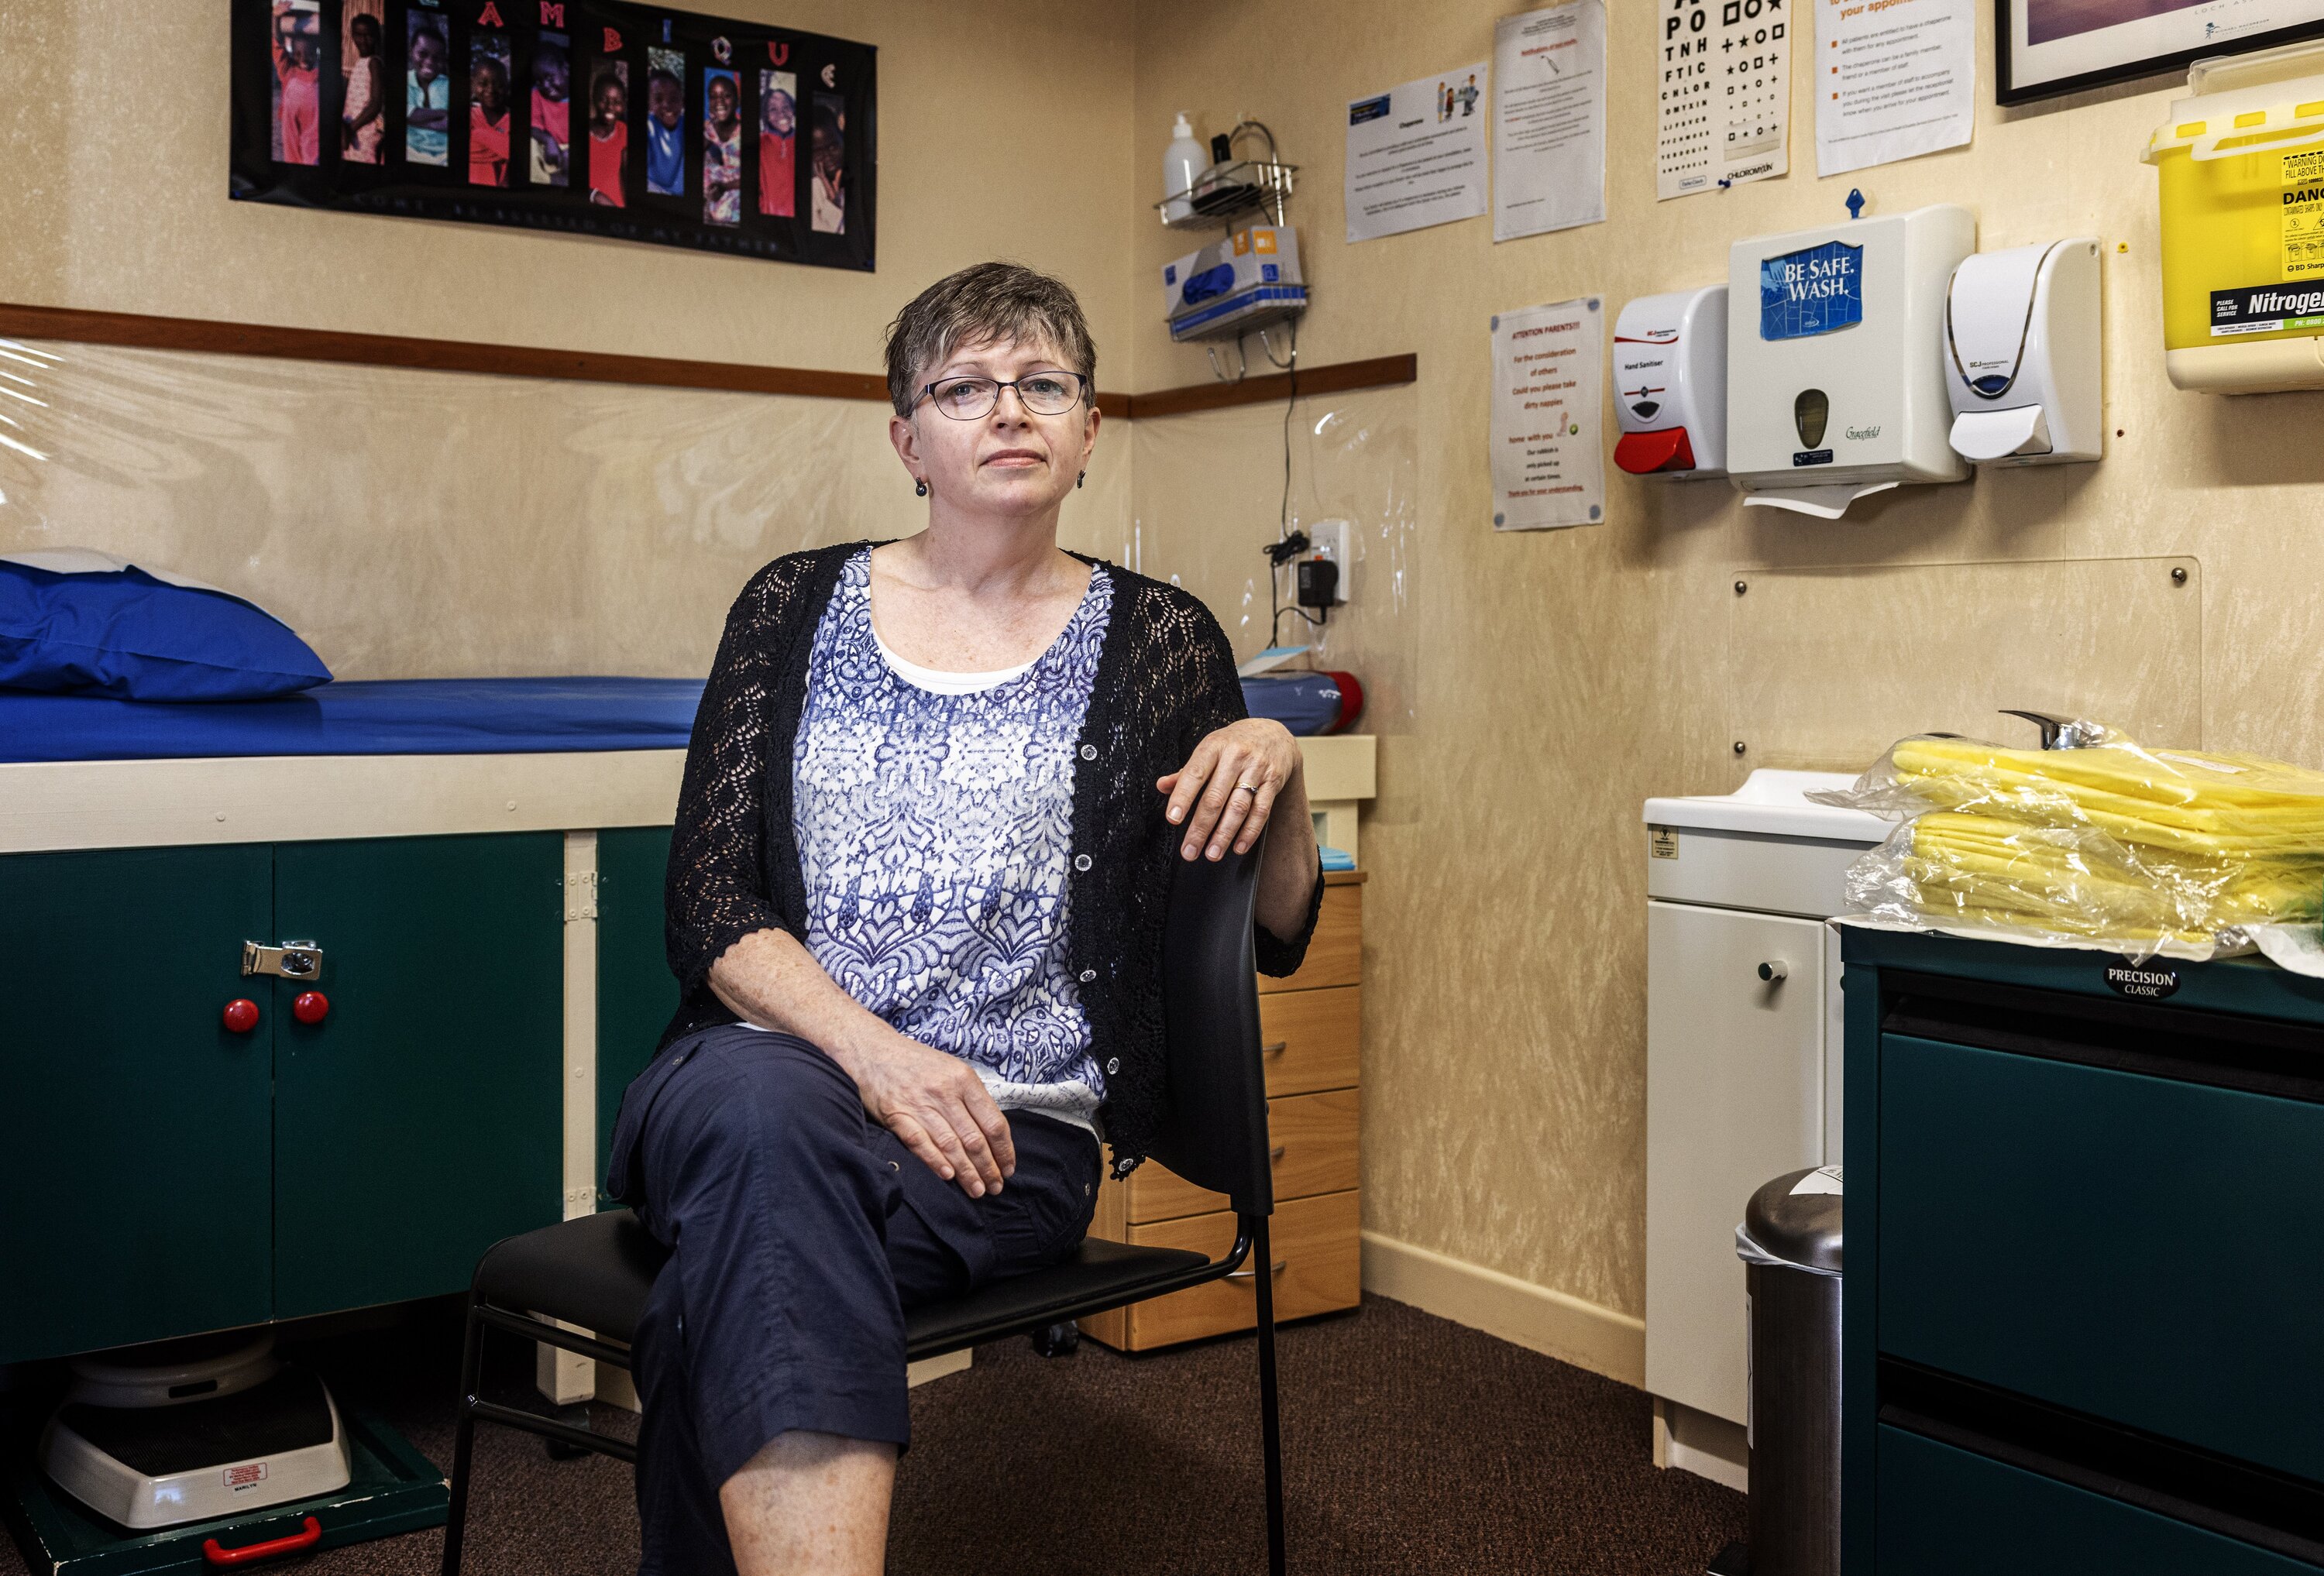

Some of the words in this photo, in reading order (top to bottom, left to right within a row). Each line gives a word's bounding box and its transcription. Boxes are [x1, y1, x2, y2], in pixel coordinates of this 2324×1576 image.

[1841, 4, 1865, 20] your
[1925, 15, 1952, 26] chaperone
[2288, 156, 2317, 169] WARNING
[2319, 155, 2324, 164] D
[2285, 169, 2297, 179] FILL
[2298, 165, 2317, 177] ABOVE
[1785, 263, 1806, 283] BE
[1810, 256, 1855, 280] SAFE.
[1789, 277, 1849, 302] WASH.
[1535, 348, 1576, 360] consideration
[1639, 360, 1663, 369] Sanitiser
[1530, 368, 1538, 377] of
[1538, 367, 1557, 376] others
[1512, 386, 1528, 396] Could
[1530, 386, 1542, 394] you
[1542, 383, 1562, 392] please
[1563, 380, 1576, 389] take
[1524, 401, 1538, 410] dirty
[1539, 399, 1563, 408] nappies
[1528, 433, 1541, 441] with
[1542, 433, 1554, 442] you
[1846, 426, 1882, 441] Gracefield
[2109, 968, 2174, 987] PRECISION
[2125, 984, 2161, 997] CLASSIC
[234, 1482, 257, 1492] MARILYN
